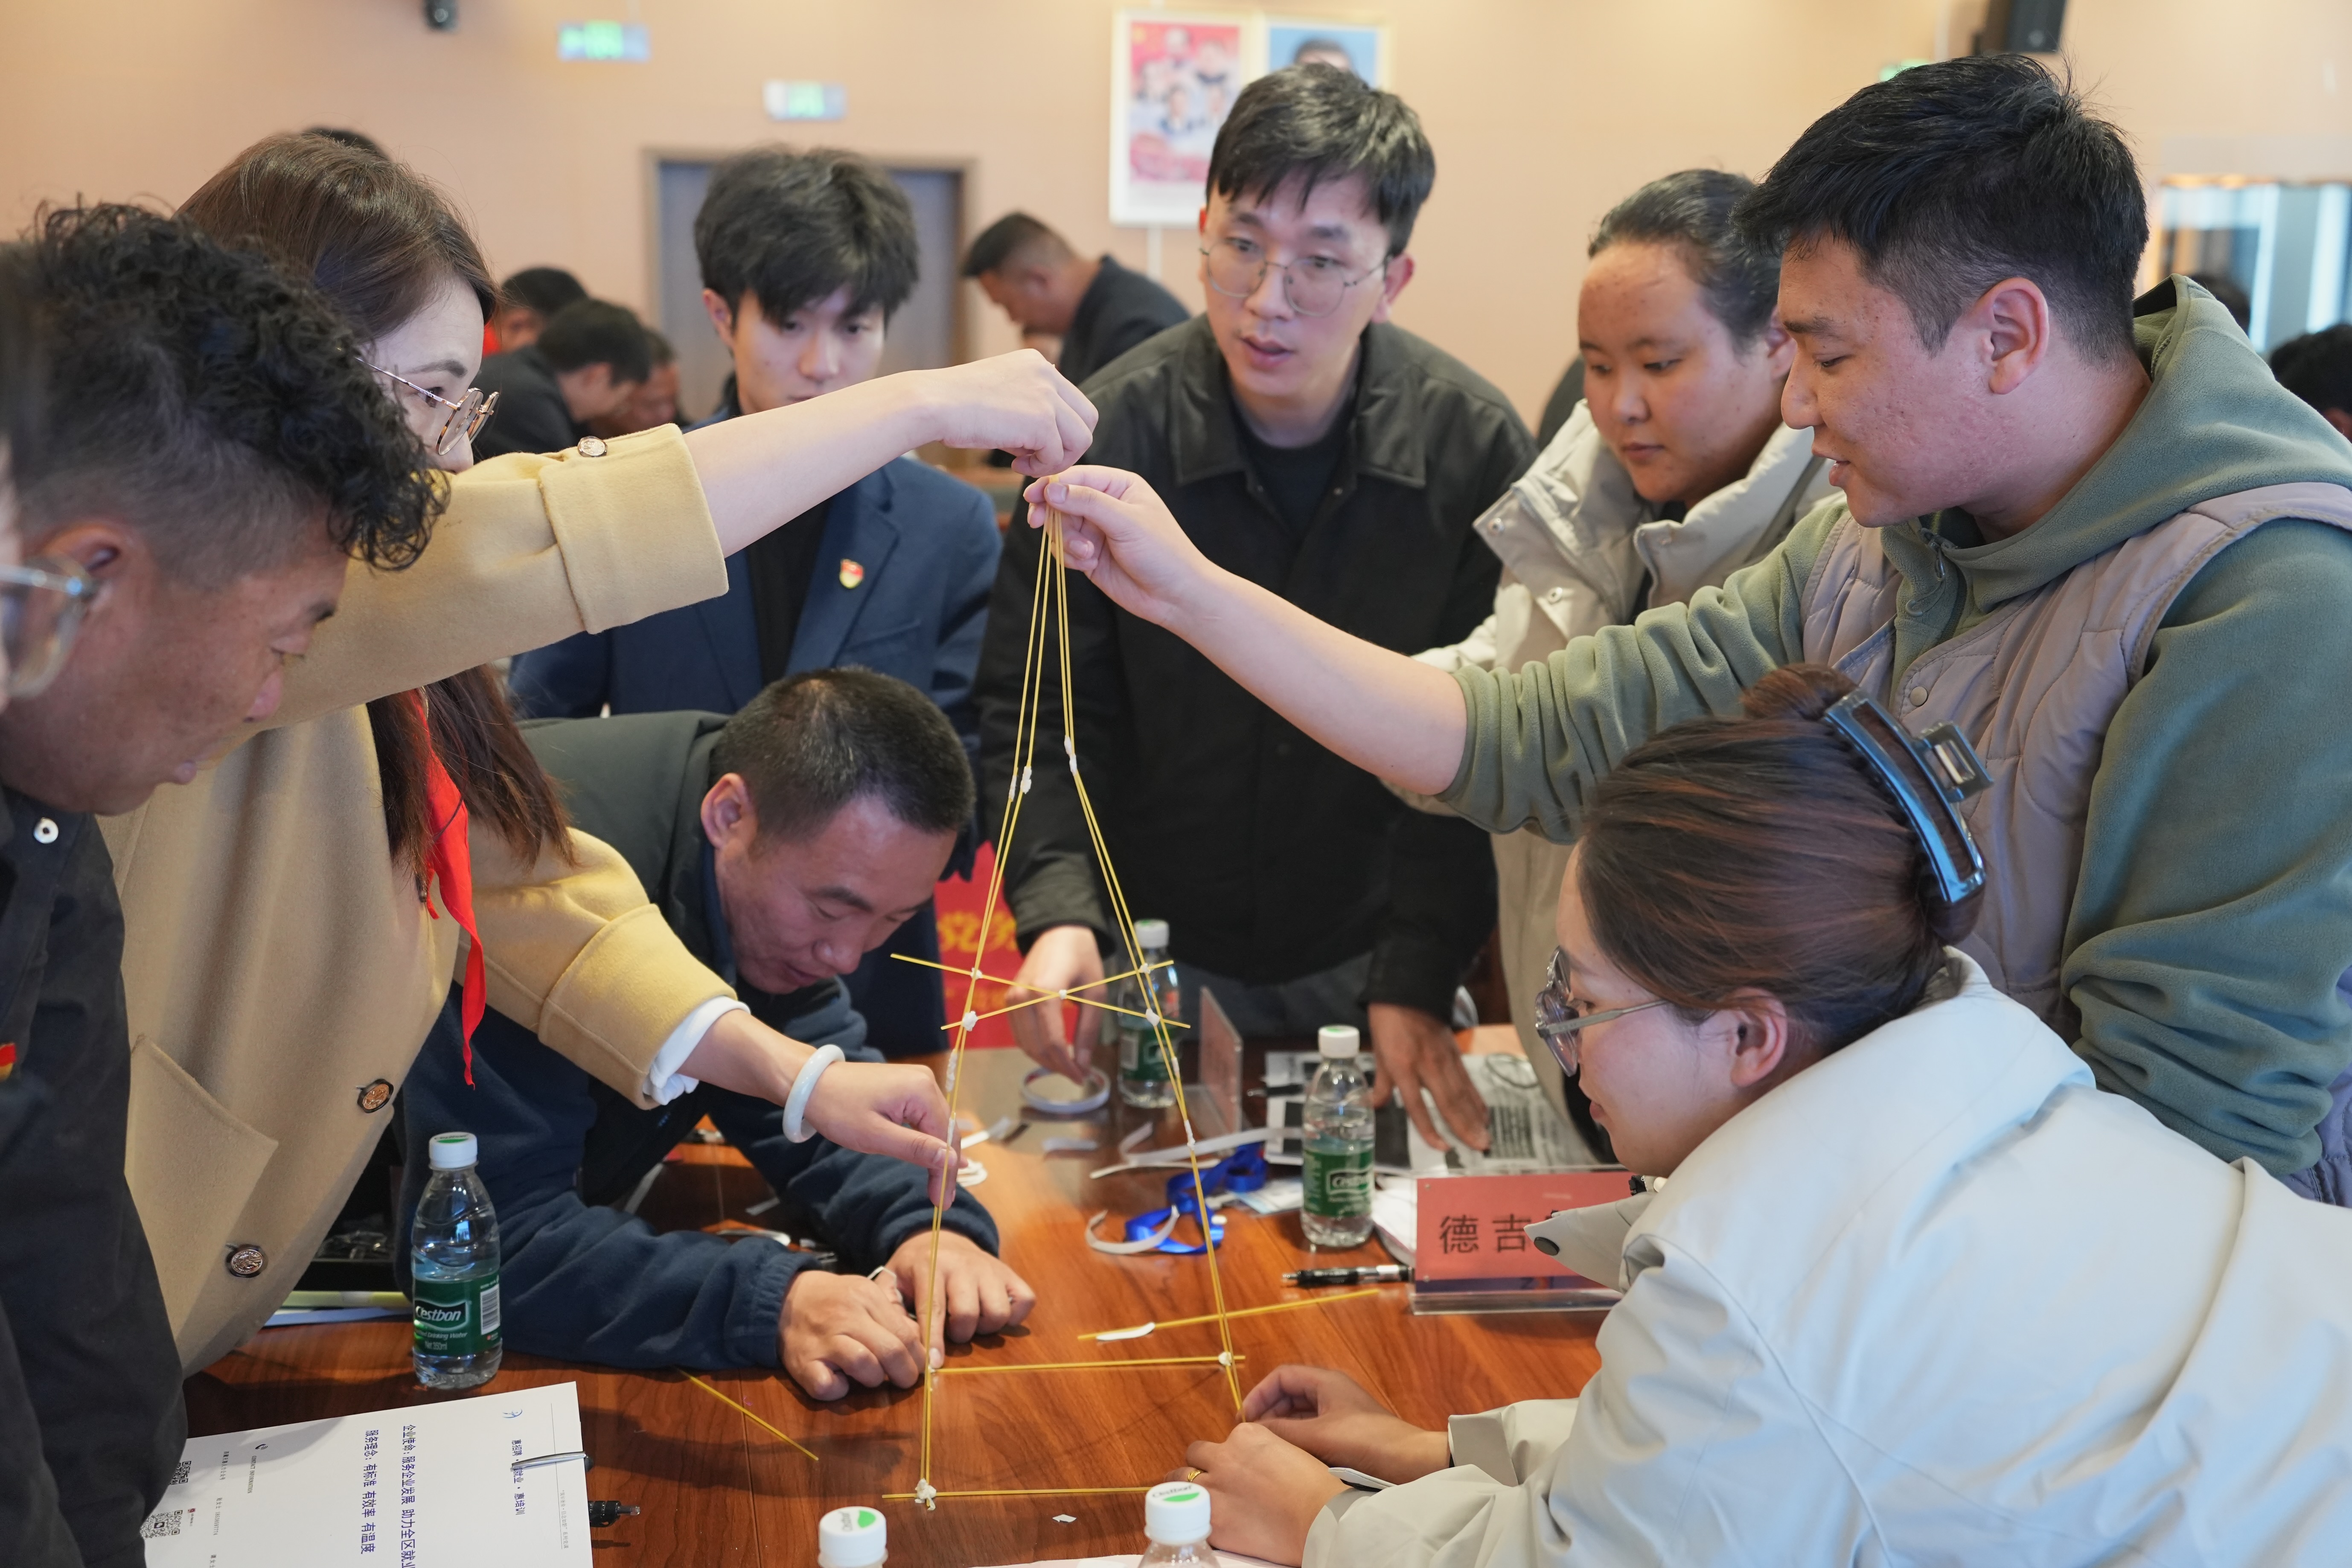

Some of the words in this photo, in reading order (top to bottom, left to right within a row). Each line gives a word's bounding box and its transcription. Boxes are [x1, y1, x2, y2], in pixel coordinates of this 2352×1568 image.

[1439, 1210, 1559, 1254] 德吉
[363, 1463, 378, 1487] 有标准
[512, 1467, 524, 1484] 就业
[361, 1491, 377, 1518] 有效率
[514, 1492, 525, 1515] 惠培训
[361, 1522, 376, 1554] 有温度
